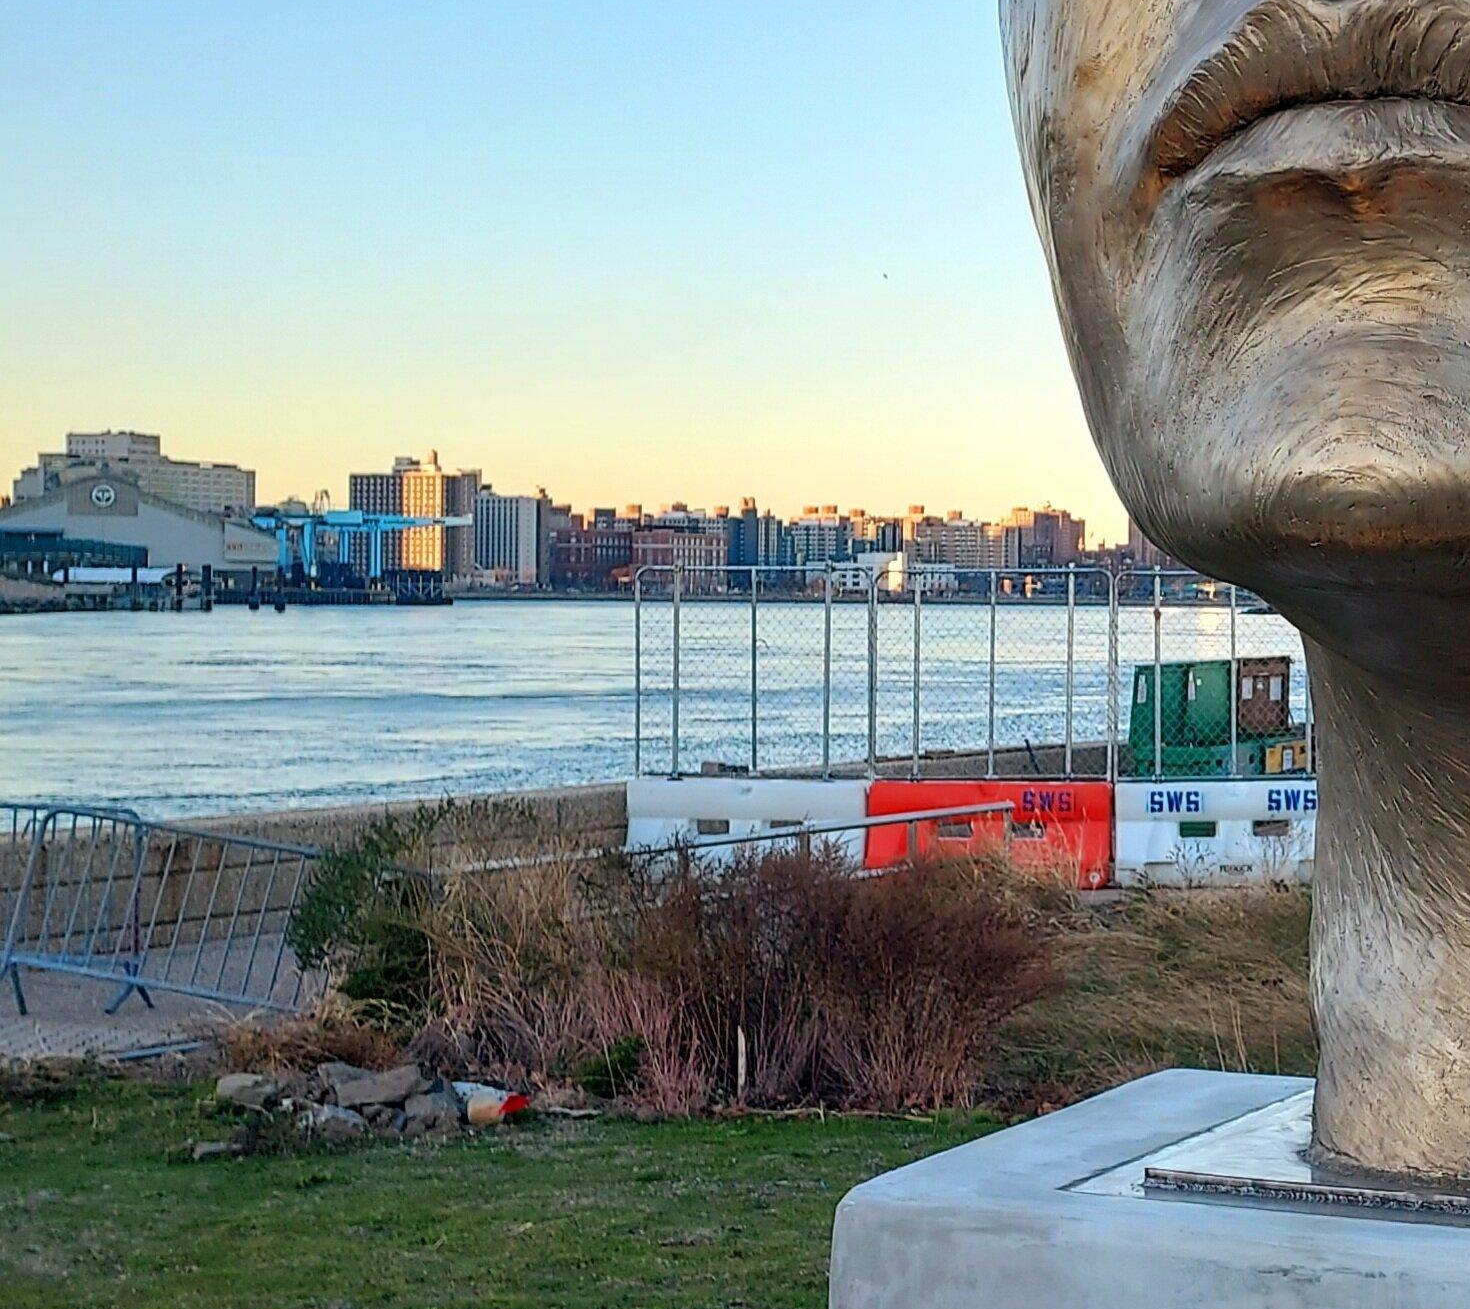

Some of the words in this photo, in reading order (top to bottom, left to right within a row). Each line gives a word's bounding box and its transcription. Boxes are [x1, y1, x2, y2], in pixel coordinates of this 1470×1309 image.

[1022, 790, 1072, 813] SWS
[1150, 790, 1200, 813] SWS
[1267, 789, 1317, 812] SWS
